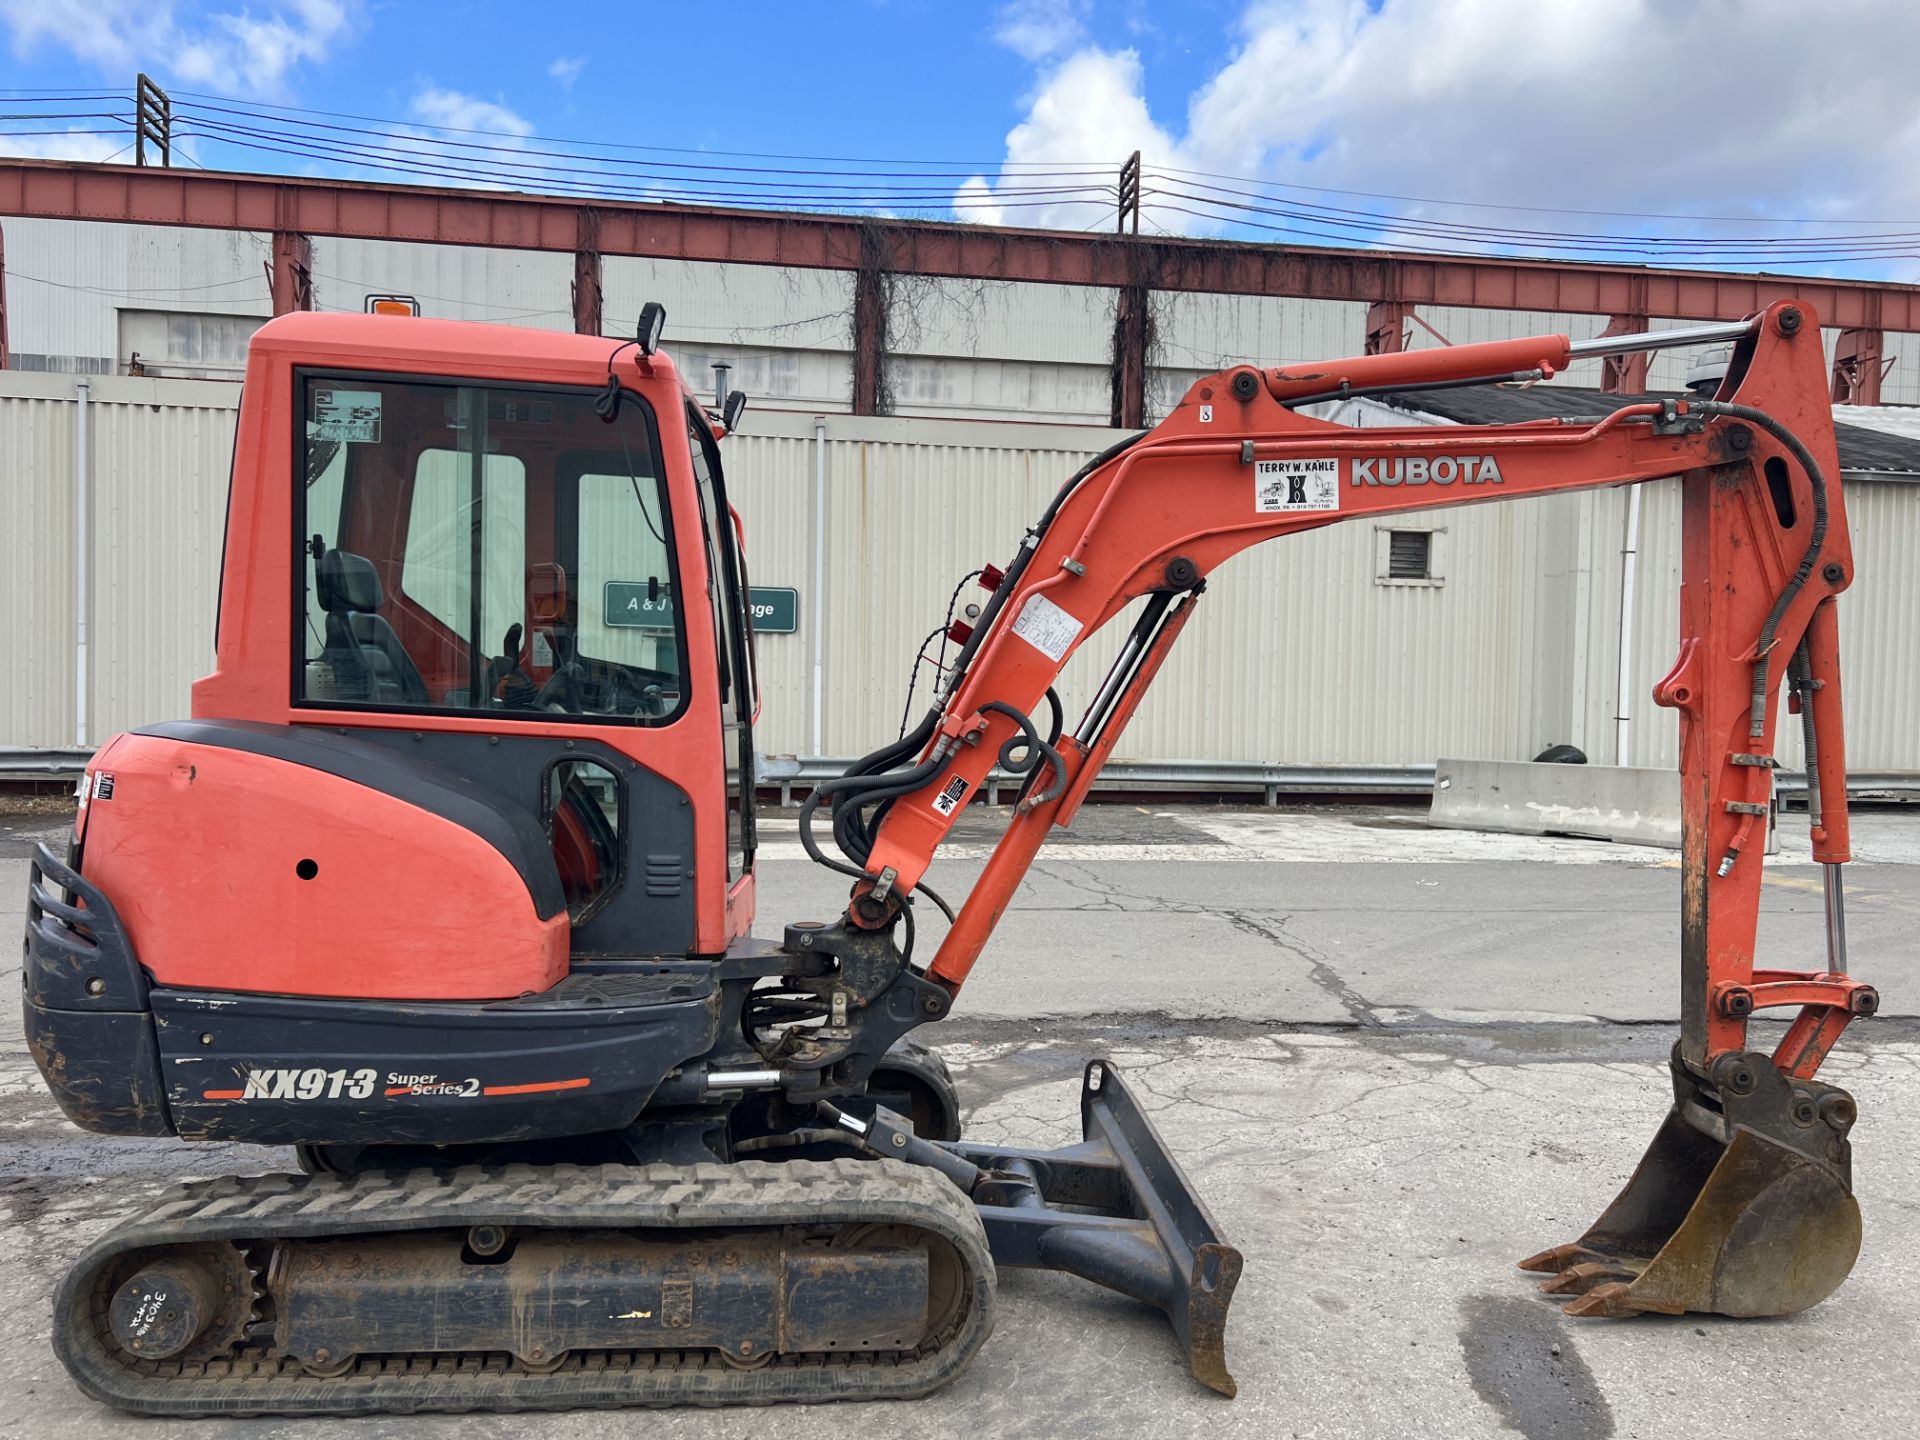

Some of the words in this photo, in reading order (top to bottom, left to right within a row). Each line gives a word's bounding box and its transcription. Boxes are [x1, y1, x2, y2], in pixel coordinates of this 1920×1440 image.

[1258, 462, 1291, 473] TERRY
[1292, 462, 1303, 472] W.
[1305, 461, 1335, 472] KAHLE
[1351, 455, 1504, 486] KUBOTA
[1286, 475, 1307, 503] K
[627, 597, 638, 610] A
[642, 598, 653, 611] &
[657, 598, 667, 611] J
[241, 1068, 377, 1099] KX91-3
[387, 1072, 438, 1087] Super
[145, 1291, 167, 1323] 3403
